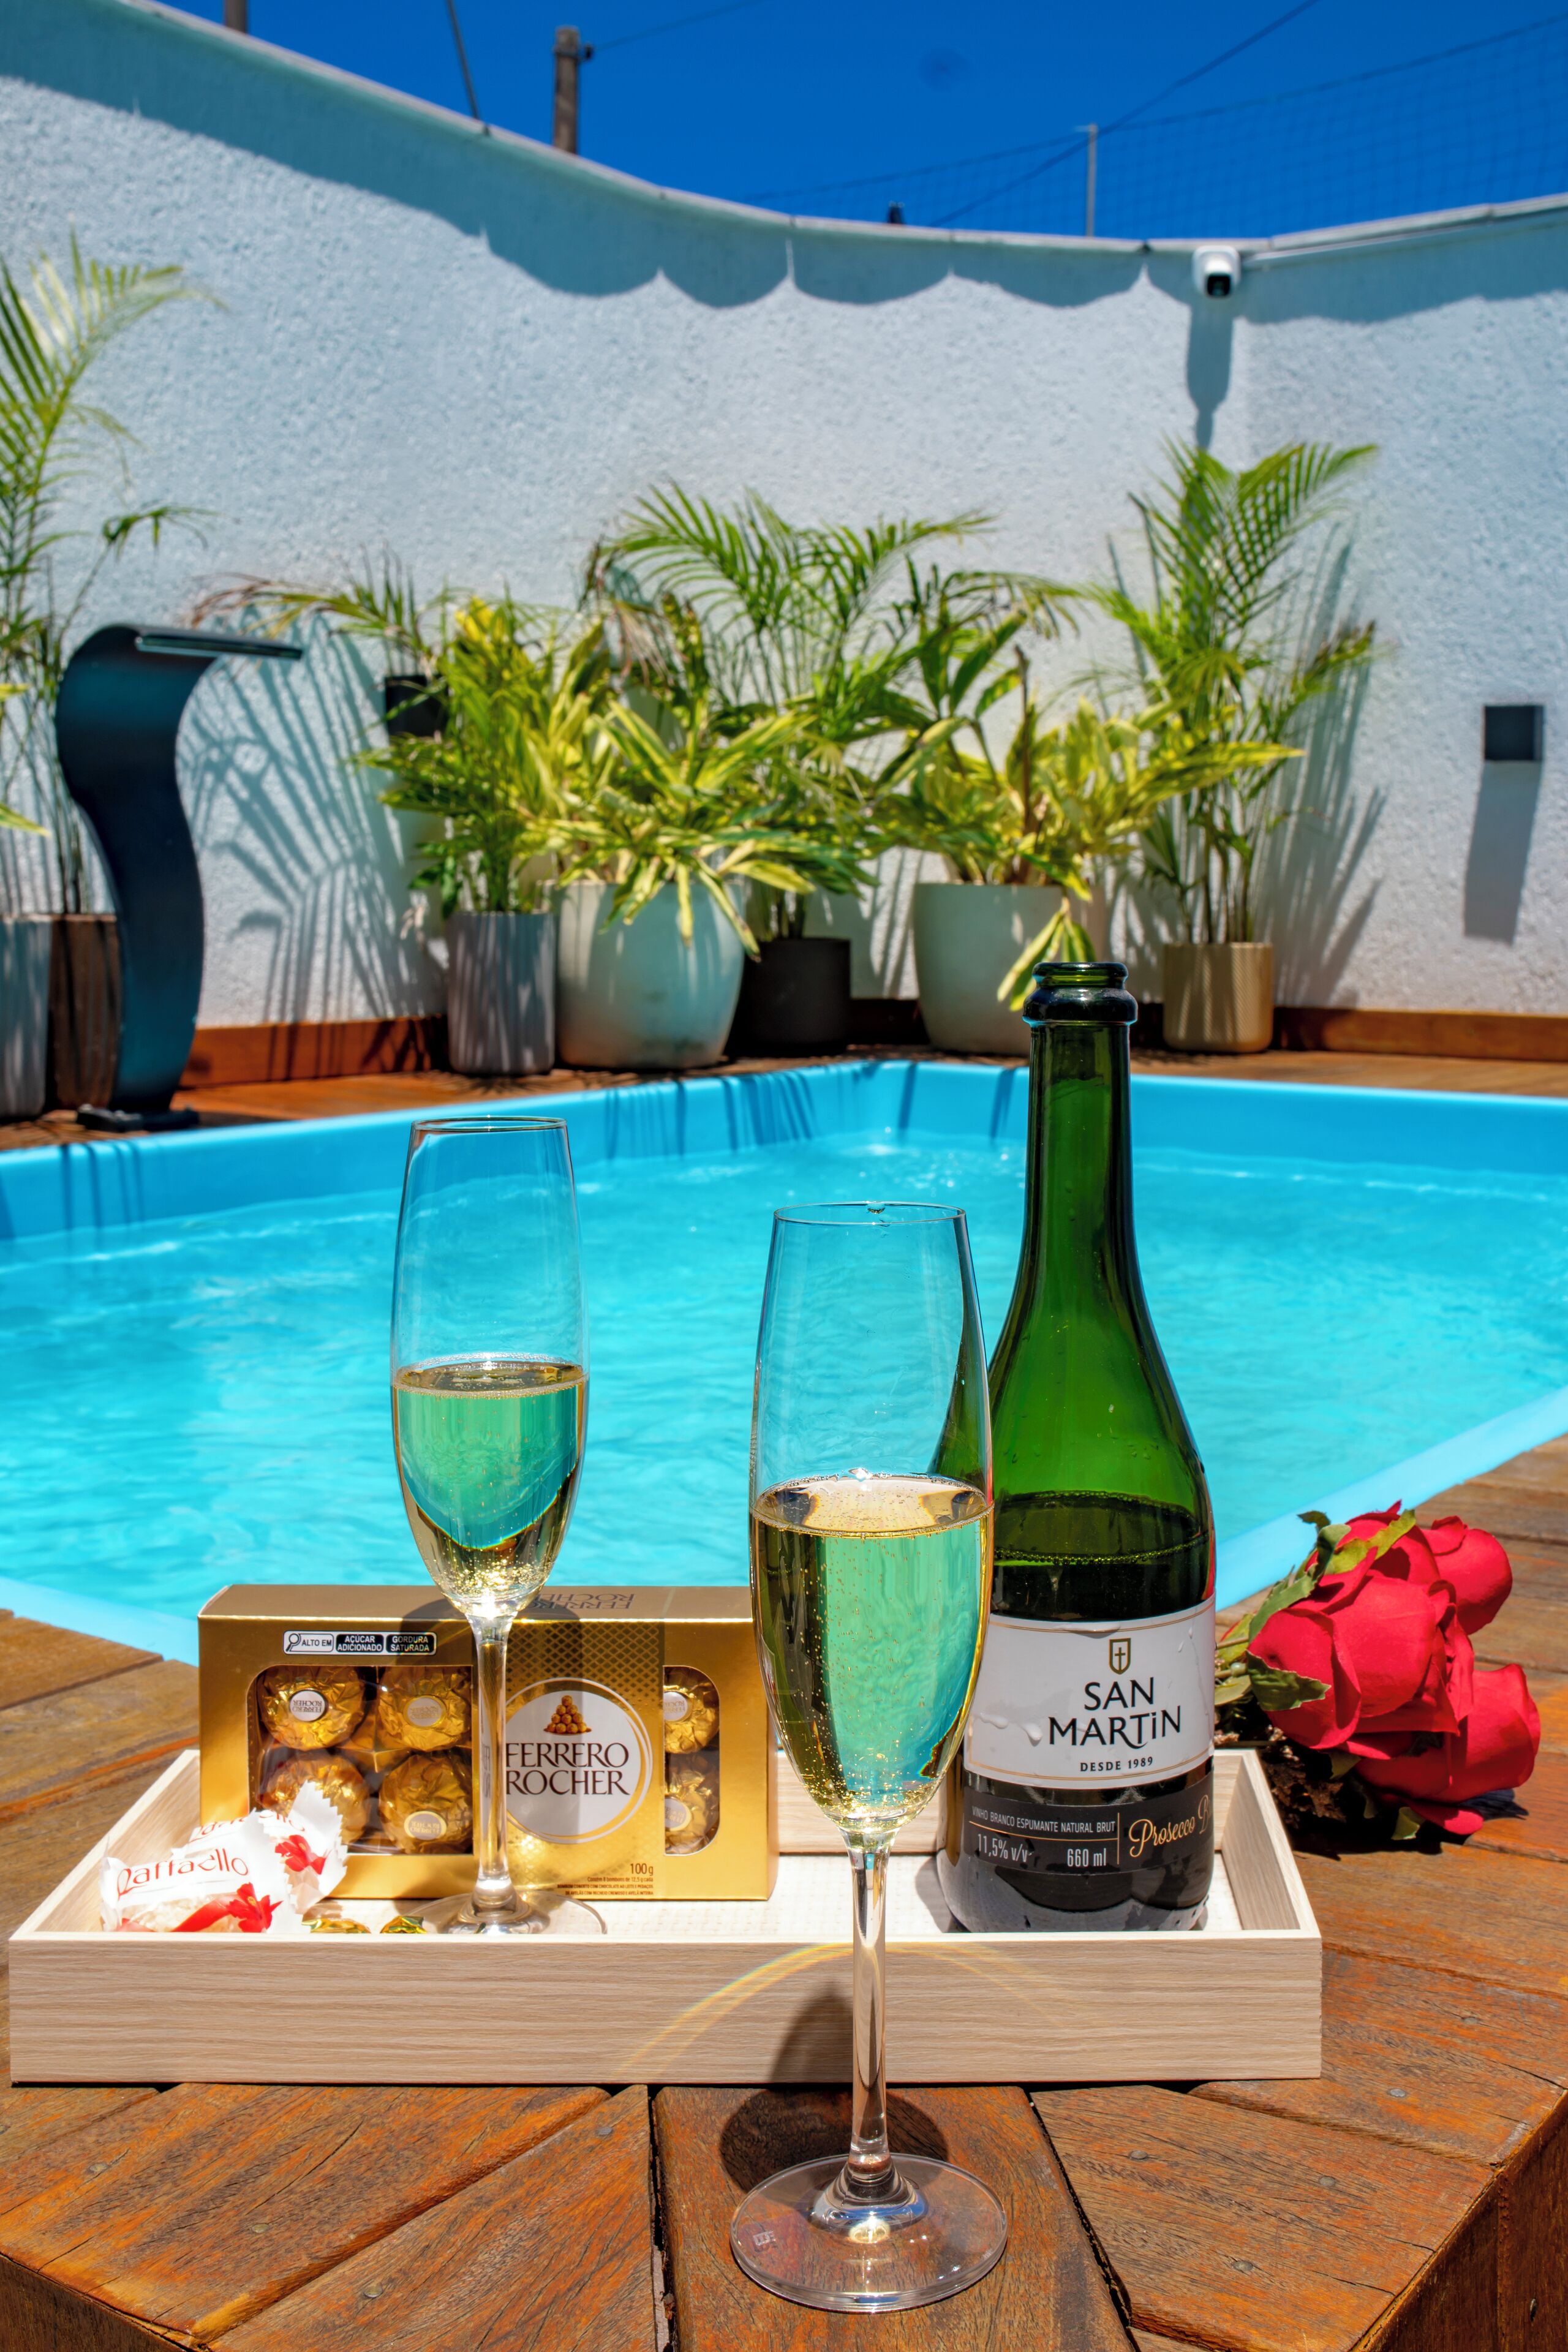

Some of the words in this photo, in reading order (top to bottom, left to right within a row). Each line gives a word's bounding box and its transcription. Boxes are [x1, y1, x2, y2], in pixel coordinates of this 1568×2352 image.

[344, 1634, 375, 1645] AÇÚCAR
[1084, 1677, 1154, 1711] SAN
[506, 1743, 629, 1768] FERRERO
[1080, 1761, 1121, 1772] DESDE
[1128, 1757, 1153, 1769] 1989
[506, 1770, 630, 1795] ROCHER
[972, 1806, 989, 1820] VINHO
[990, 1812, 1015, 1826] BRANCO
[1017, 1819, 1058, 1833] ESPUMANTE
[1061, 1822, 1093, 1833] NATURAL
[1096, 1821, 1115, 1833] BRUT
[978, 1834, 1008, 1859] 11,5%
[1129, 1817, 1195, 1857] Prosecco
[630, 1863, 647, 1874] 100
[648, 1866, 654, 1876] g
[1067, 1848, 1089, 1867] 660
[1093, 1848, 1107, 1866] ml
[117, 1849, 249, 1901] Raffaello
